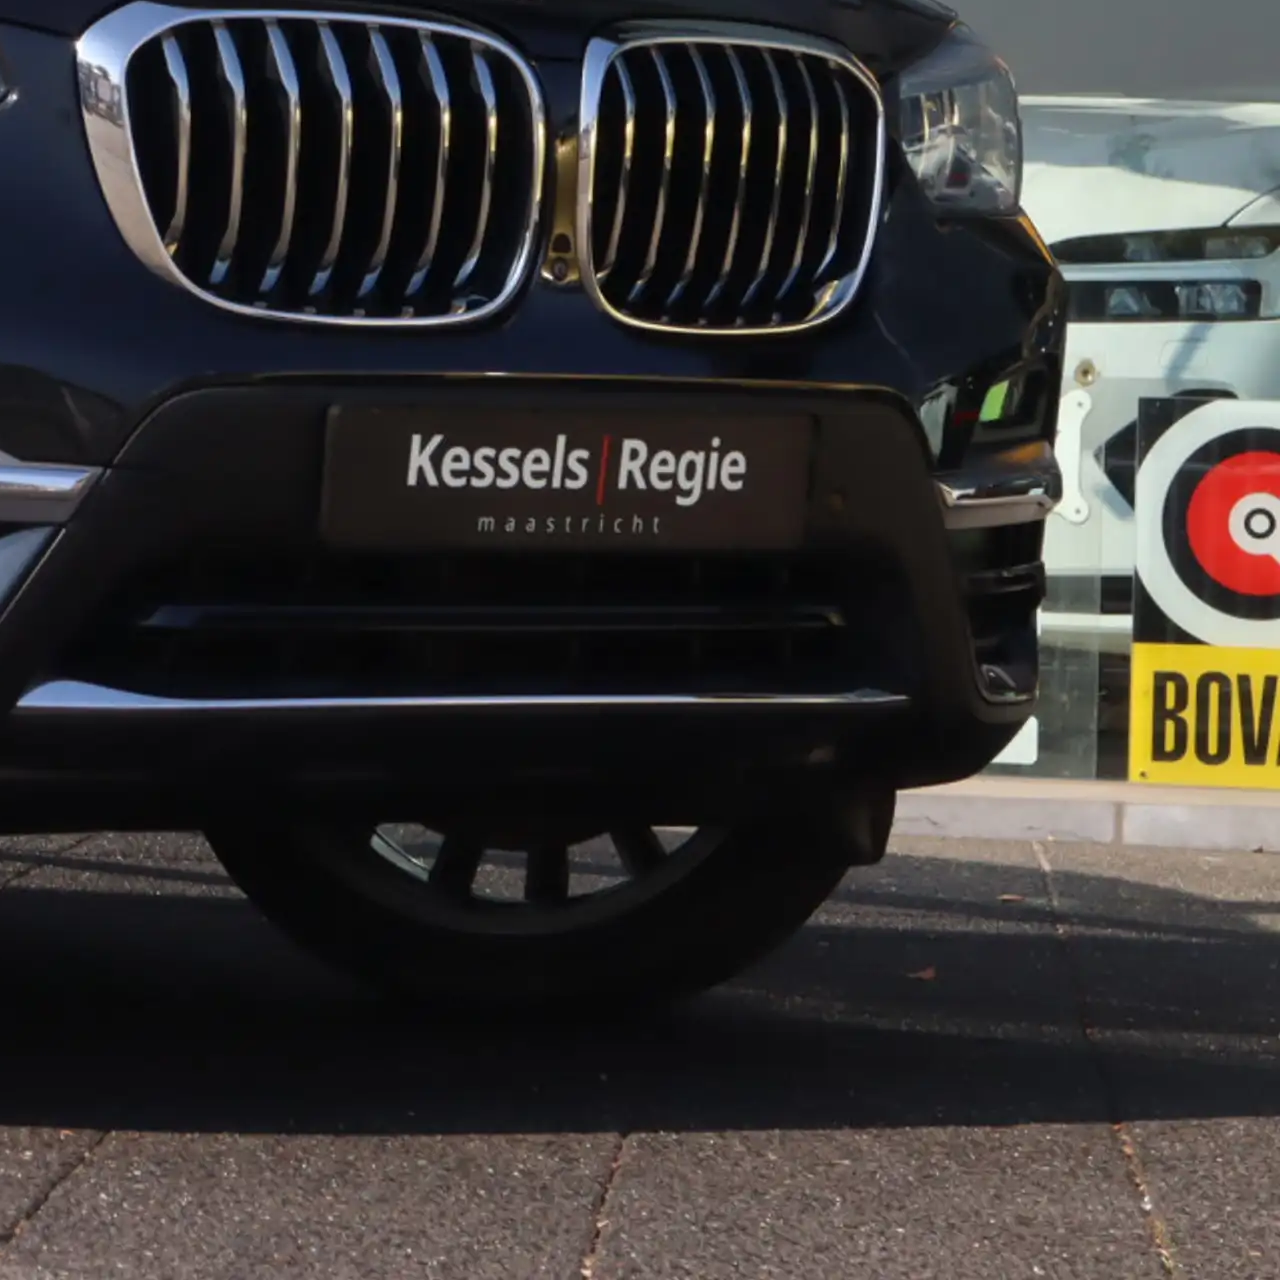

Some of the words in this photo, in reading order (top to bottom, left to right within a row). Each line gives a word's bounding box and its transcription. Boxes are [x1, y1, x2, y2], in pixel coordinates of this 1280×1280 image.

[406, 433, 590, 491] Kessels
[617, 436, 748, 507] Regie
[476, 513, 661, 534] maastricht
[1151, 671, 1280, 767] BOV
